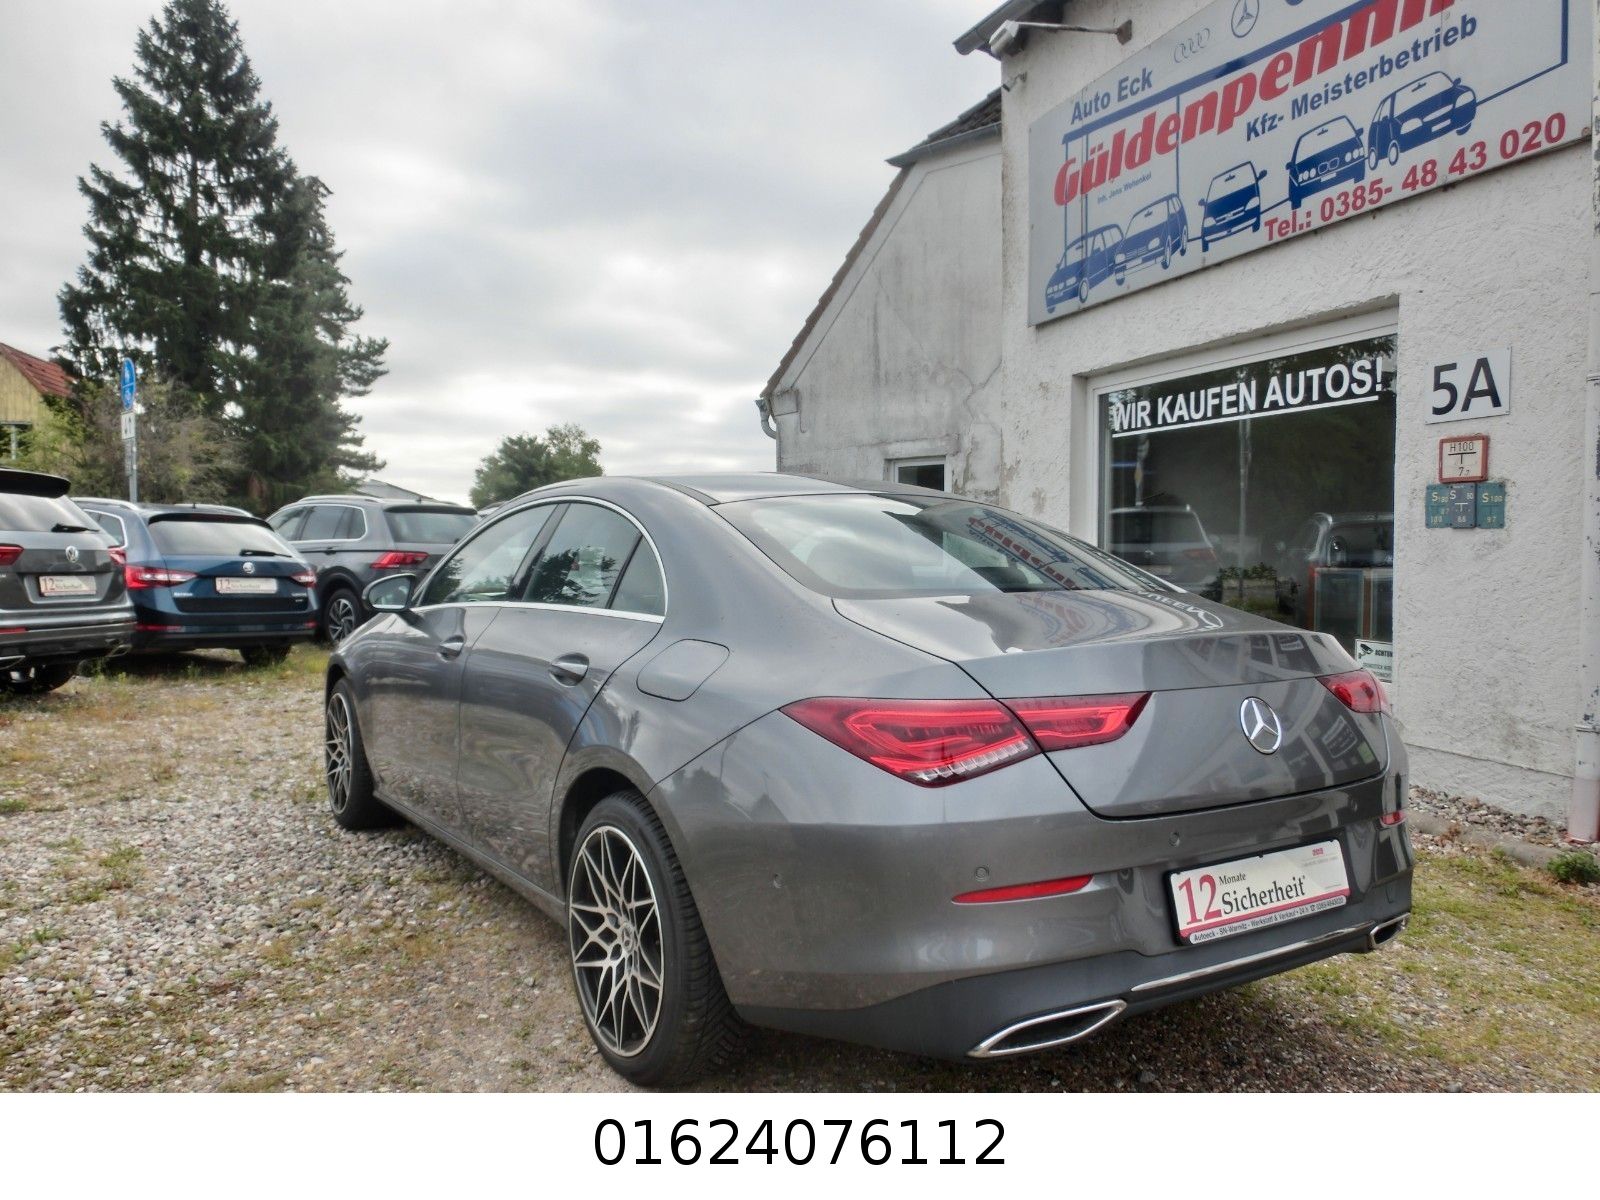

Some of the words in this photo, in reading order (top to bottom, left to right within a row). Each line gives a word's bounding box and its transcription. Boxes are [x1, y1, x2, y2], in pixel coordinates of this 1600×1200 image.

[1070, 87, 1111, 125] Auto
[1116, 66, 1154, 103] Eck
[1246, 111, 1285, 142] Kfz-
[1290, 13, 1478, 121] Meisterbetrieb
[1264, 209, 1313, 242] Tel.:
[1319, 177, 1394, 223] 0385-
[1401, 158, 1439, 192] 48
[1447, 140, 1488, 176] 43
[1499, 111, 1567, 160] 020
[1111, 399, 1152, 432] WIR
[1157, 379, 1257, 424] KAUFEN
[1263, 356, 1383, 410] AUTOS!
[1431, 357, 1503, 416] 5A
[1178, 873, 1224, 926] 12
[1218, 871, 1247, 887] Monate
